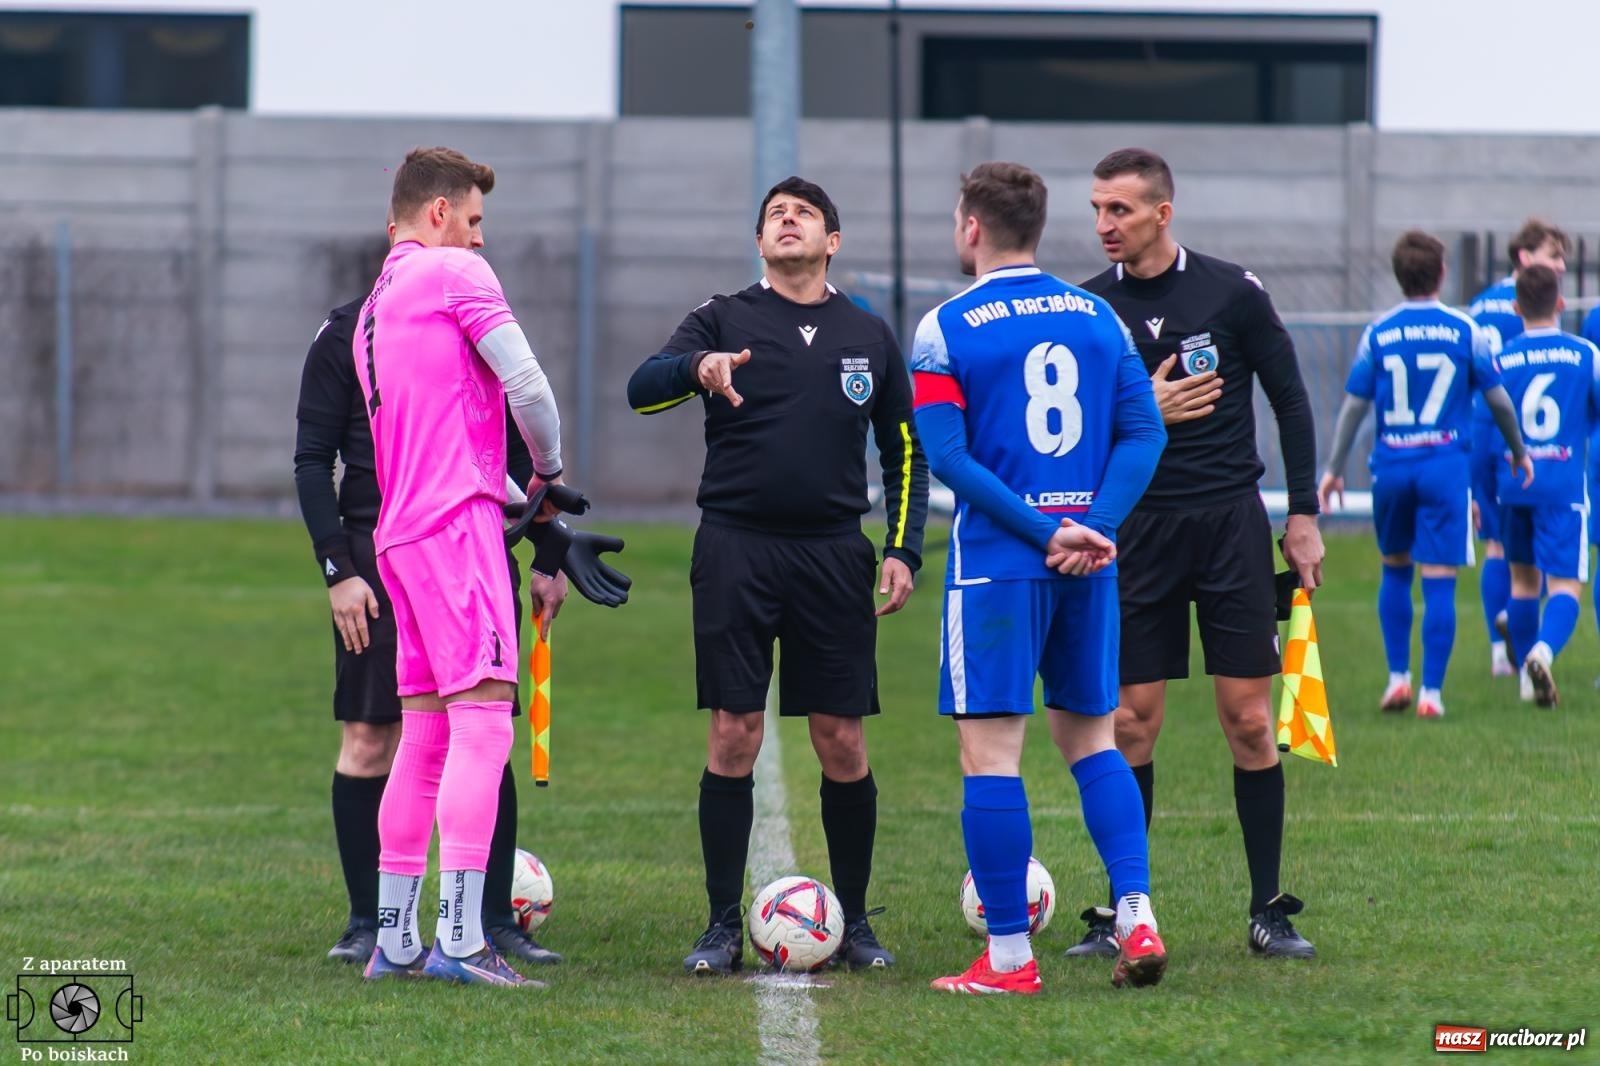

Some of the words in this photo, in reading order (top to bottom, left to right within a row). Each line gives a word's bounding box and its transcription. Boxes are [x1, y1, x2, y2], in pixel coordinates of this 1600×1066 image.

[962, 301, 1011, 328] UNIA
[1012, 291, 1098, 316] RACIBÓRZ
[1023, 341, 1084, 458] 8
[1382, 352, 1457, 426] 17
[1521, 372, 1561, 442] 6
[491, 630, 503, 668] 1
